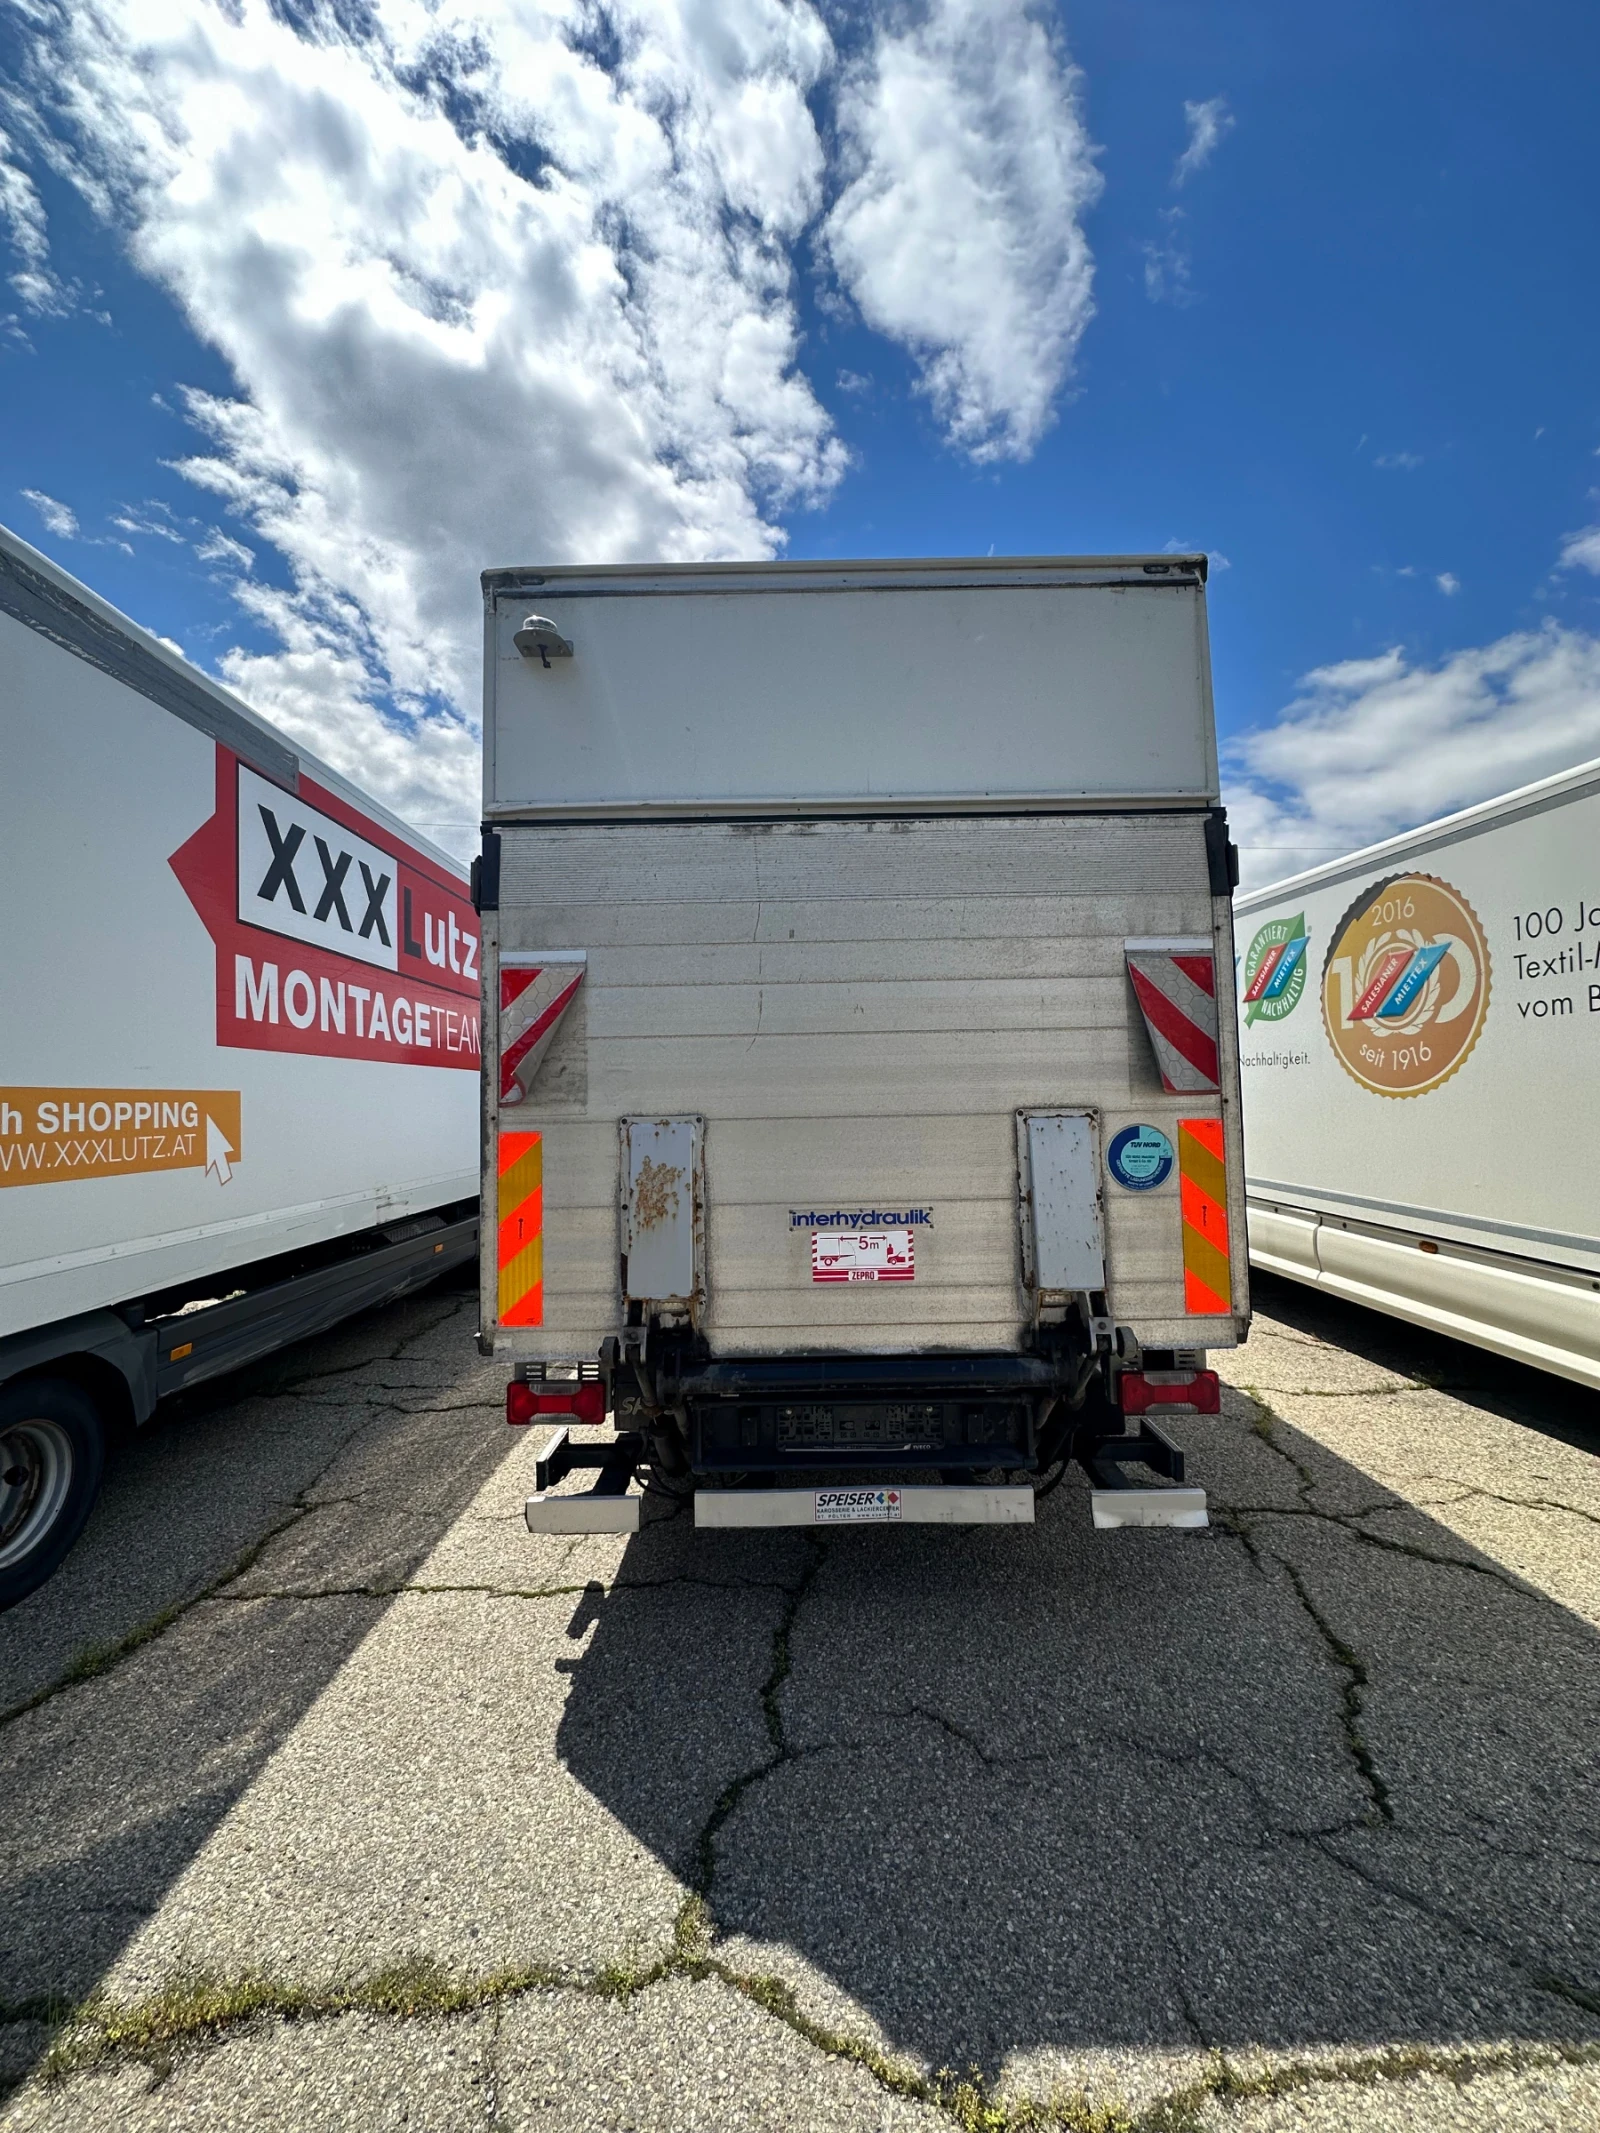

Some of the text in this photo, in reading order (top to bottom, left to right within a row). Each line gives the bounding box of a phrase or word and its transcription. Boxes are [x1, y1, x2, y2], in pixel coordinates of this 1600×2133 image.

[1371, 896, 1415, 927] 2016
[1513, 907, 1563, 941] 100
[1247, 925, 1288, 977] GARANTIERT
[1513, 940, 1600, 980] Textil-
[1251, 949, 1277, 997] SALESIANER
[1273, 948, 1296, 989] MIETTEX
[1361, 957, 1399, 1014] SALESIANER
[1394, 957, 1428, 1006] MIETTEX
[1261, 968, 1304, 1017] NACHHALTIG
[1517, 997, 1573, 1018] vom
[1359, 1040, 1432, 1071] seit 1916
[37, 1101, 198, 1134] SHOPPING
[792, 1209, 931, 1228] interhydraulik
[851, 1271, 875, 1280] ZEPRO
[817, 1492, 875, 1507] SPEISER
